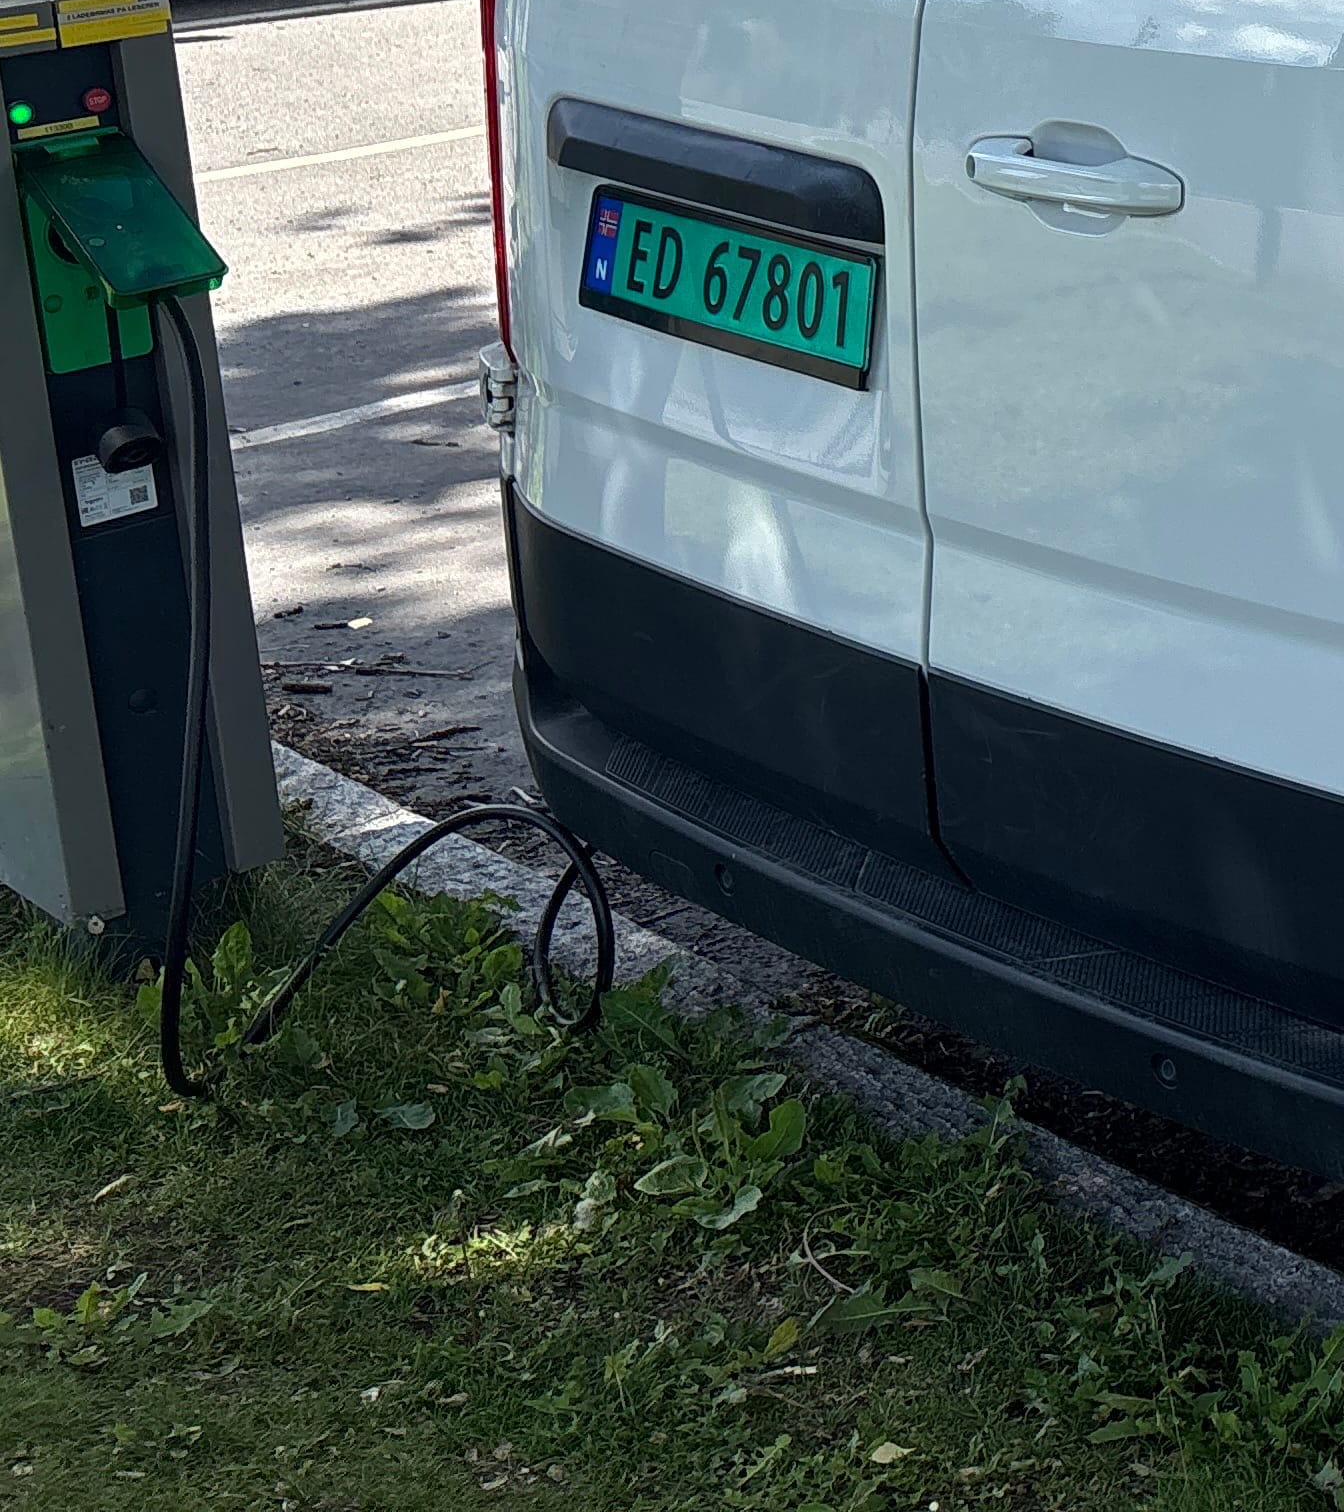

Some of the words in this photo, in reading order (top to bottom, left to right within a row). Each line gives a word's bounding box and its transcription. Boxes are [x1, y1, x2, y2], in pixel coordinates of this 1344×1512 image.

[87, 95, 108, 106] STOP
[595, 257, 607, 282] N
[626, 219, 684, 300] ED
[703, 240, 850, 348] 67801
